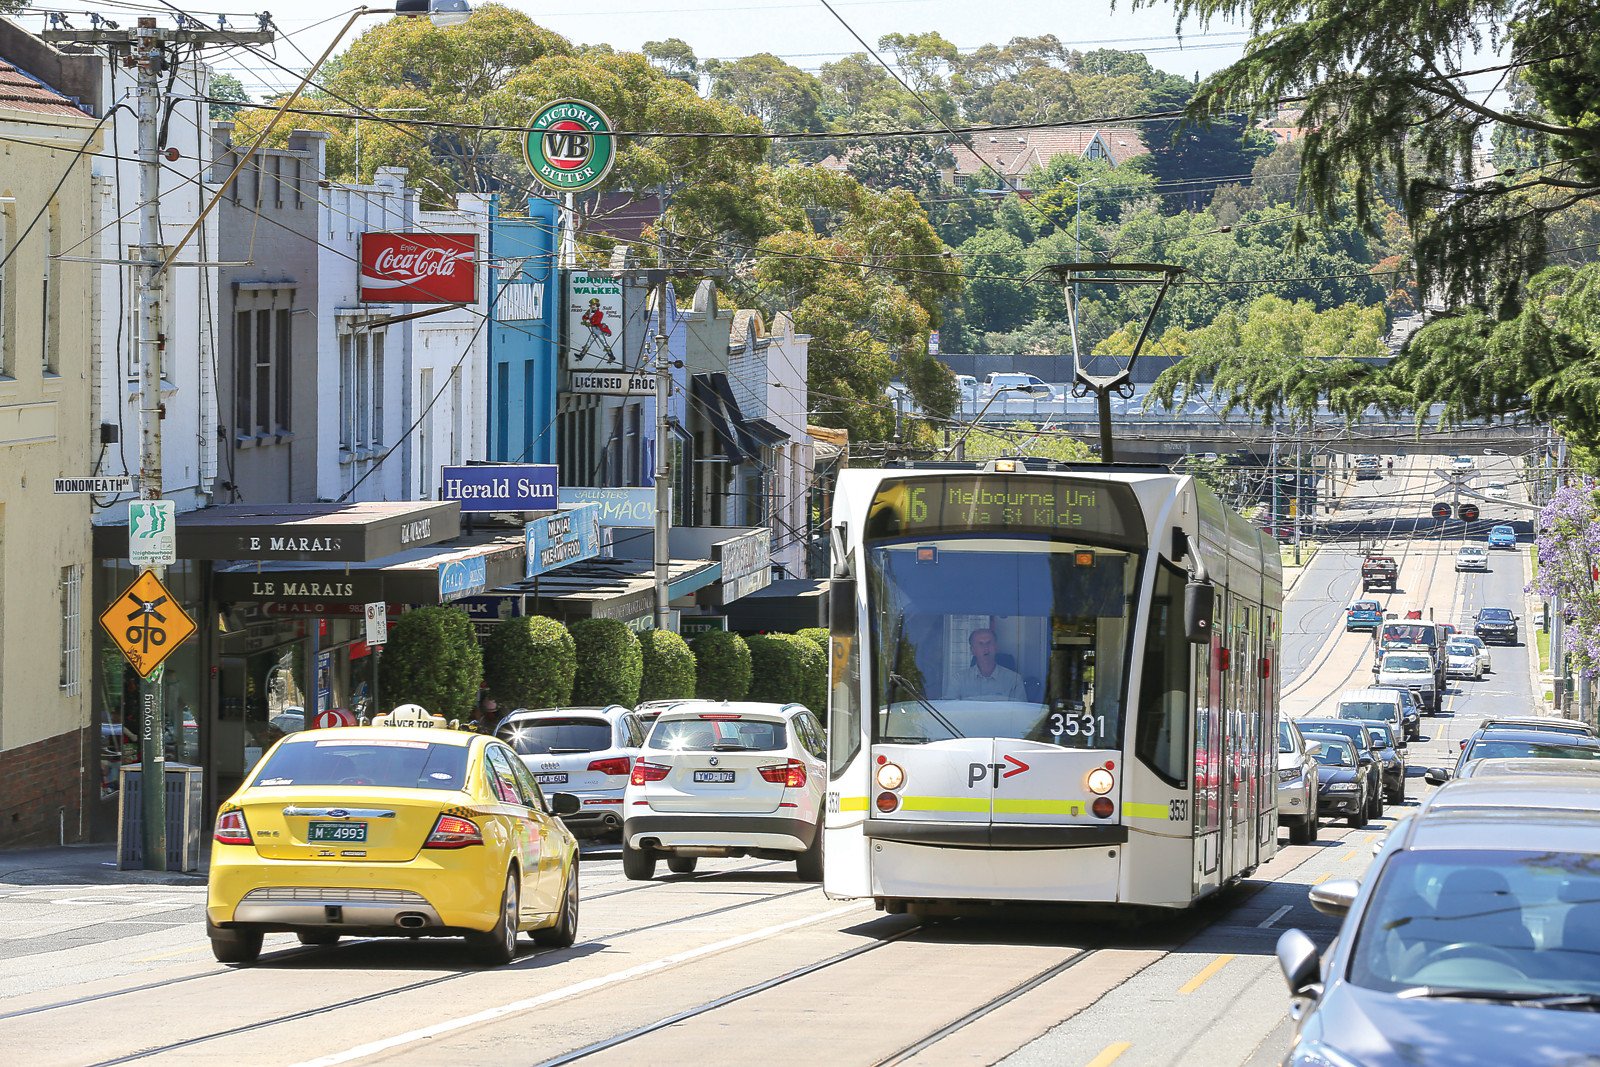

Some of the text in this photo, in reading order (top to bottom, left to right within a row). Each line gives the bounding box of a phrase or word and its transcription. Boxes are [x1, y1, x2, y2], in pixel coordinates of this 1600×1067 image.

[538, 107, 600, 131] VICTORIA
[545, 132, 590, 158] VB
[540, 164, 595, 183] BITTER
[400, 244, 418, 253] Enjoy
[375, 247, 459, 276] Coca-Cola
[573, 287, 620, 295] WALKER
[575, 377, 622, 389] LICENSED
[55, 479, 123, 492] MONOMEATH
[446, 478, 554, 499] Herald Sun
[574, 490, 629, 500] CALLISTERS
[904, 487, 1096, 523] 16 Melbourne Uni
[962, 508, 1083, 526] via St Kilda
[270, 537, 342, 551] MARAIS
[252, 582, 353, 596] LE MARAIS
[446, 572, 463, 589] HALO
[277, 603, 325, 613] HALO
[143, 693, 154, 741] Kooyong
[384, 720, 435, 728] SILVER TOP
[1050, 713, 1105, 738] 3531
[828, 792, 840, 813] 3531
[1169, 799, 1189, 821] 3531
[315, 828, 365, 839] M 4993
